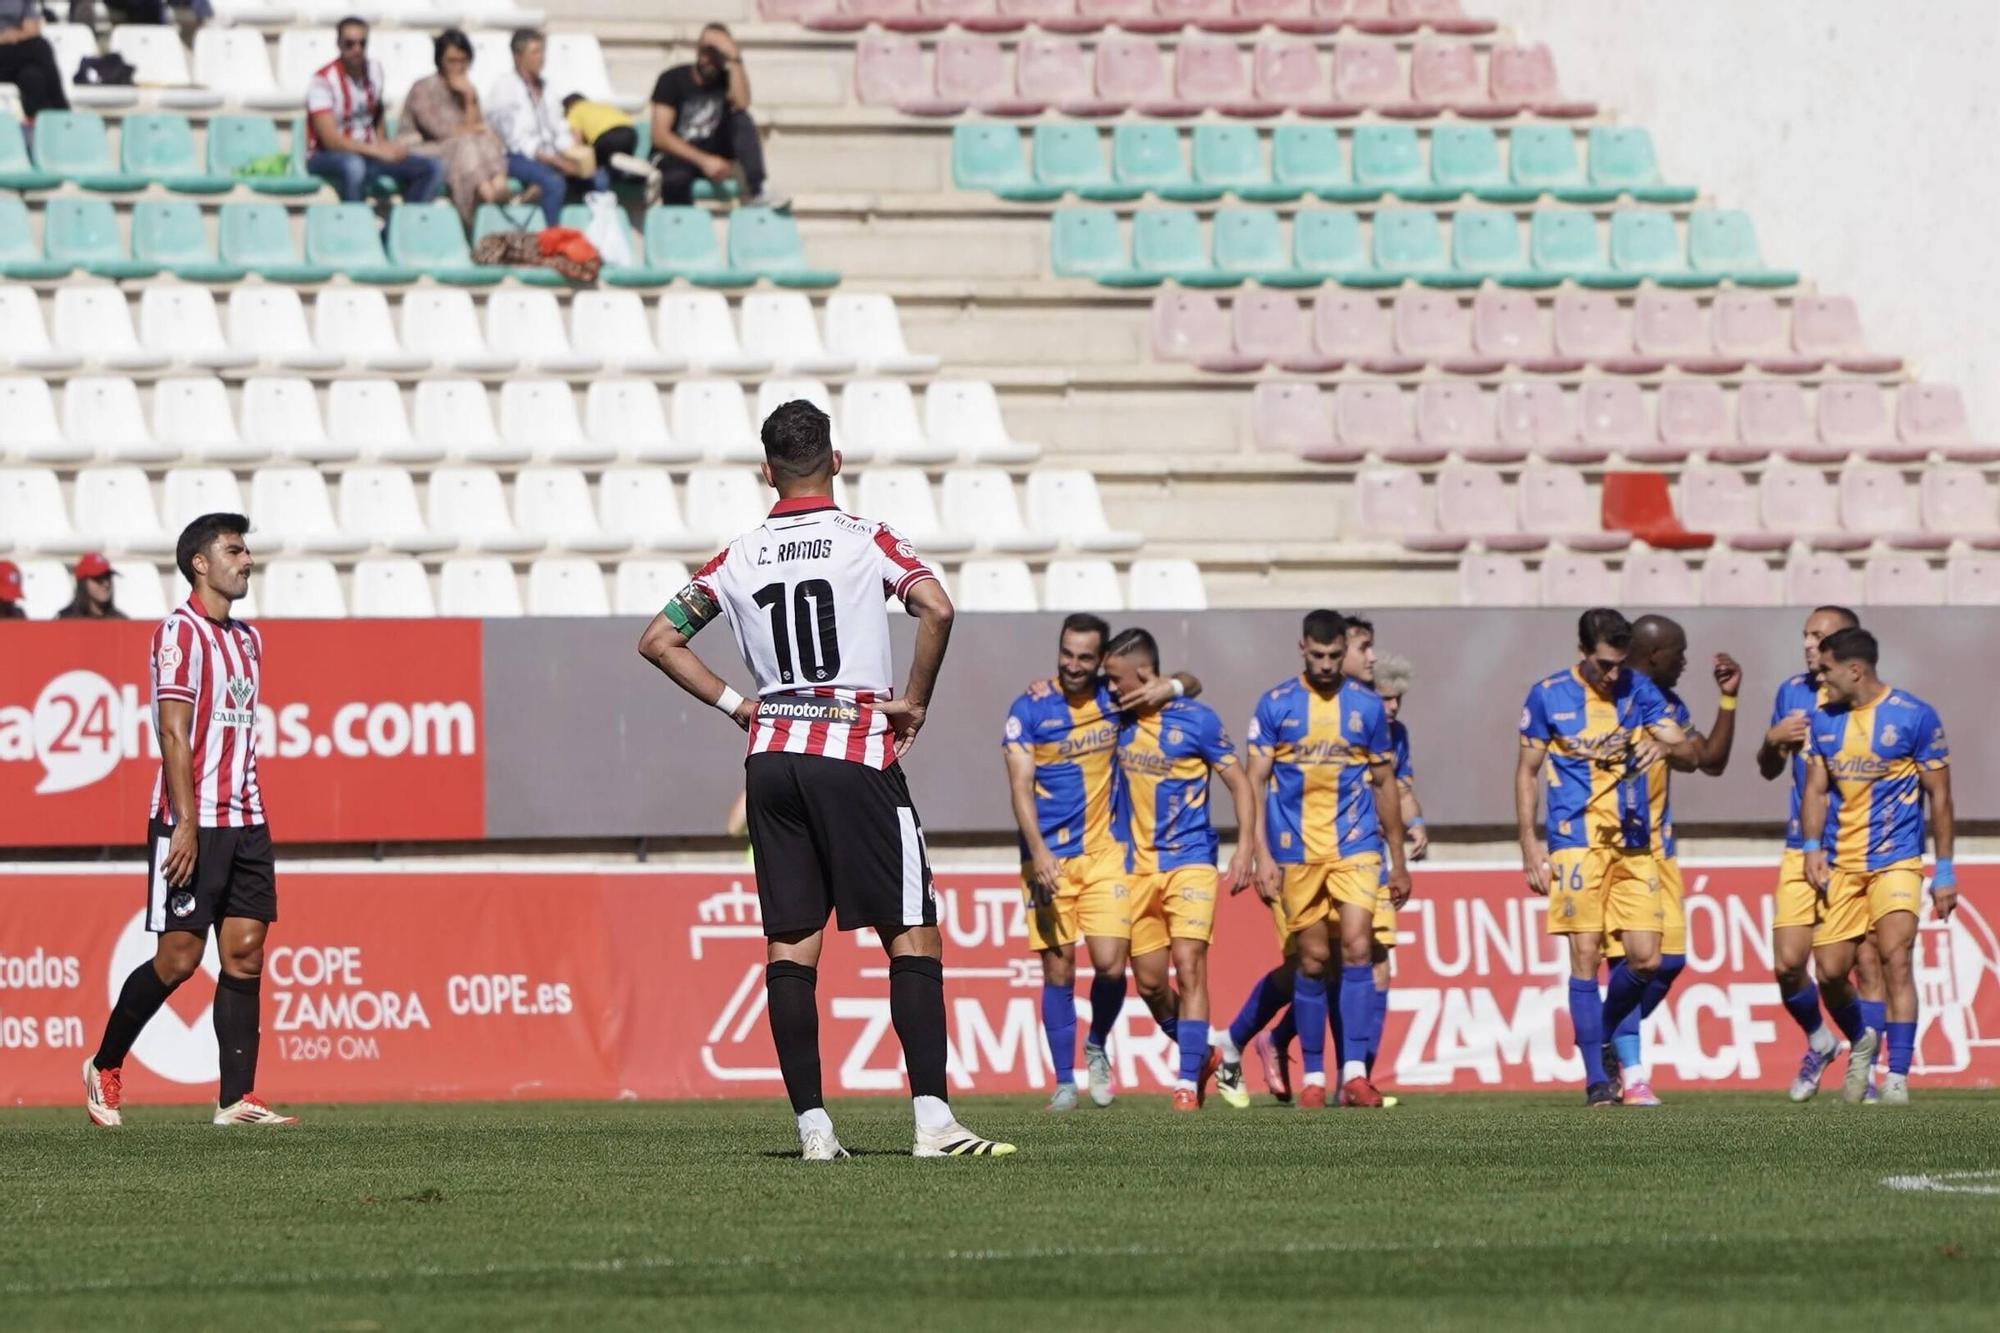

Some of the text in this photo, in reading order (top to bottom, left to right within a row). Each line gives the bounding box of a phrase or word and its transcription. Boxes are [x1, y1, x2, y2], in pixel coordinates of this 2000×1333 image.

[777, 538, 833, 563] RAMOS
[752, 578, 841, 685] 10
[268, 946, 363, 986] COPE
[272, 991, 432, 1031] ZAMORA
[448, 974, 574, 1015] COPE.es
[44, 1015, 84, 1049] en
[277, 1036, 380, 1061] 1269 OM
